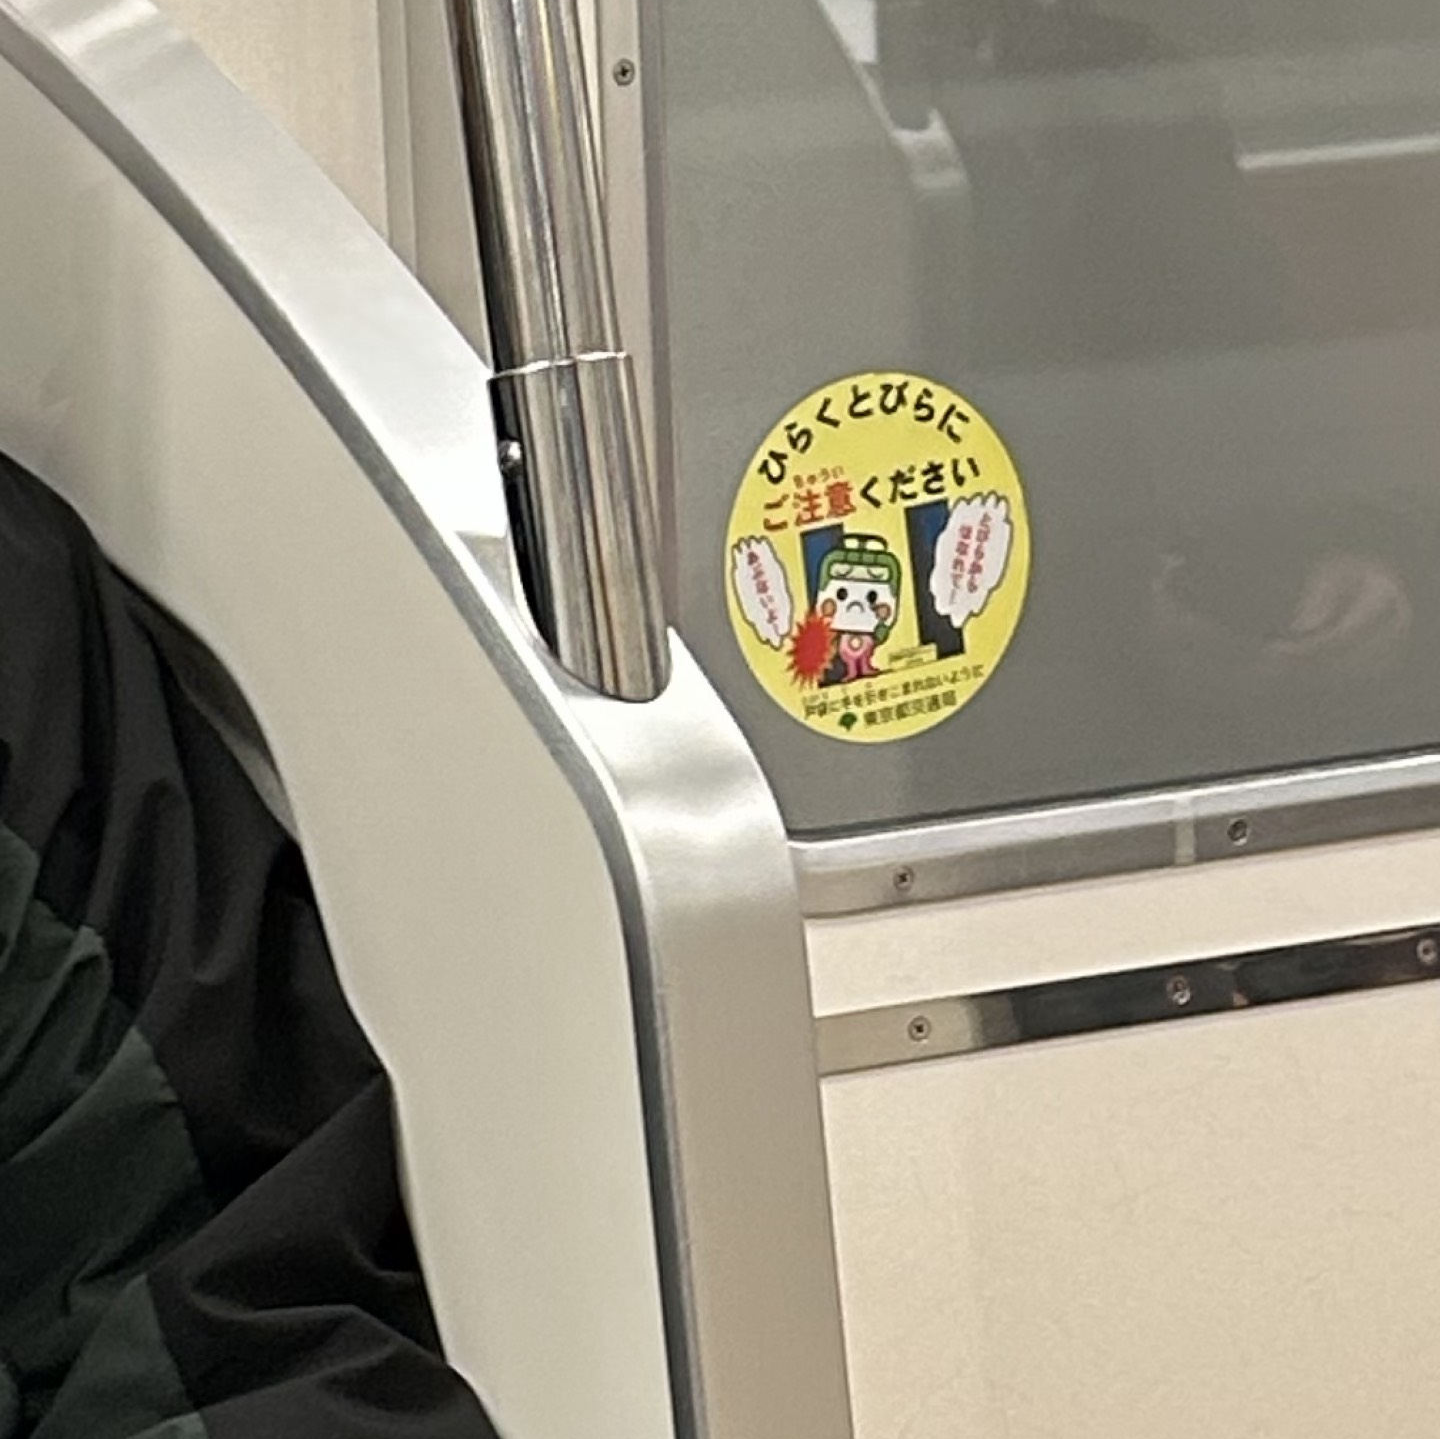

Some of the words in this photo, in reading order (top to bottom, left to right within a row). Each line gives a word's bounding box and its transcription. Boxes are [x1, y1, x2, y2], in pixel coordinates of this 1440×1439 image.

[757, 381, 971, 485] ひらくとびらに
[763, 456, 981, 532] ご注意ください
